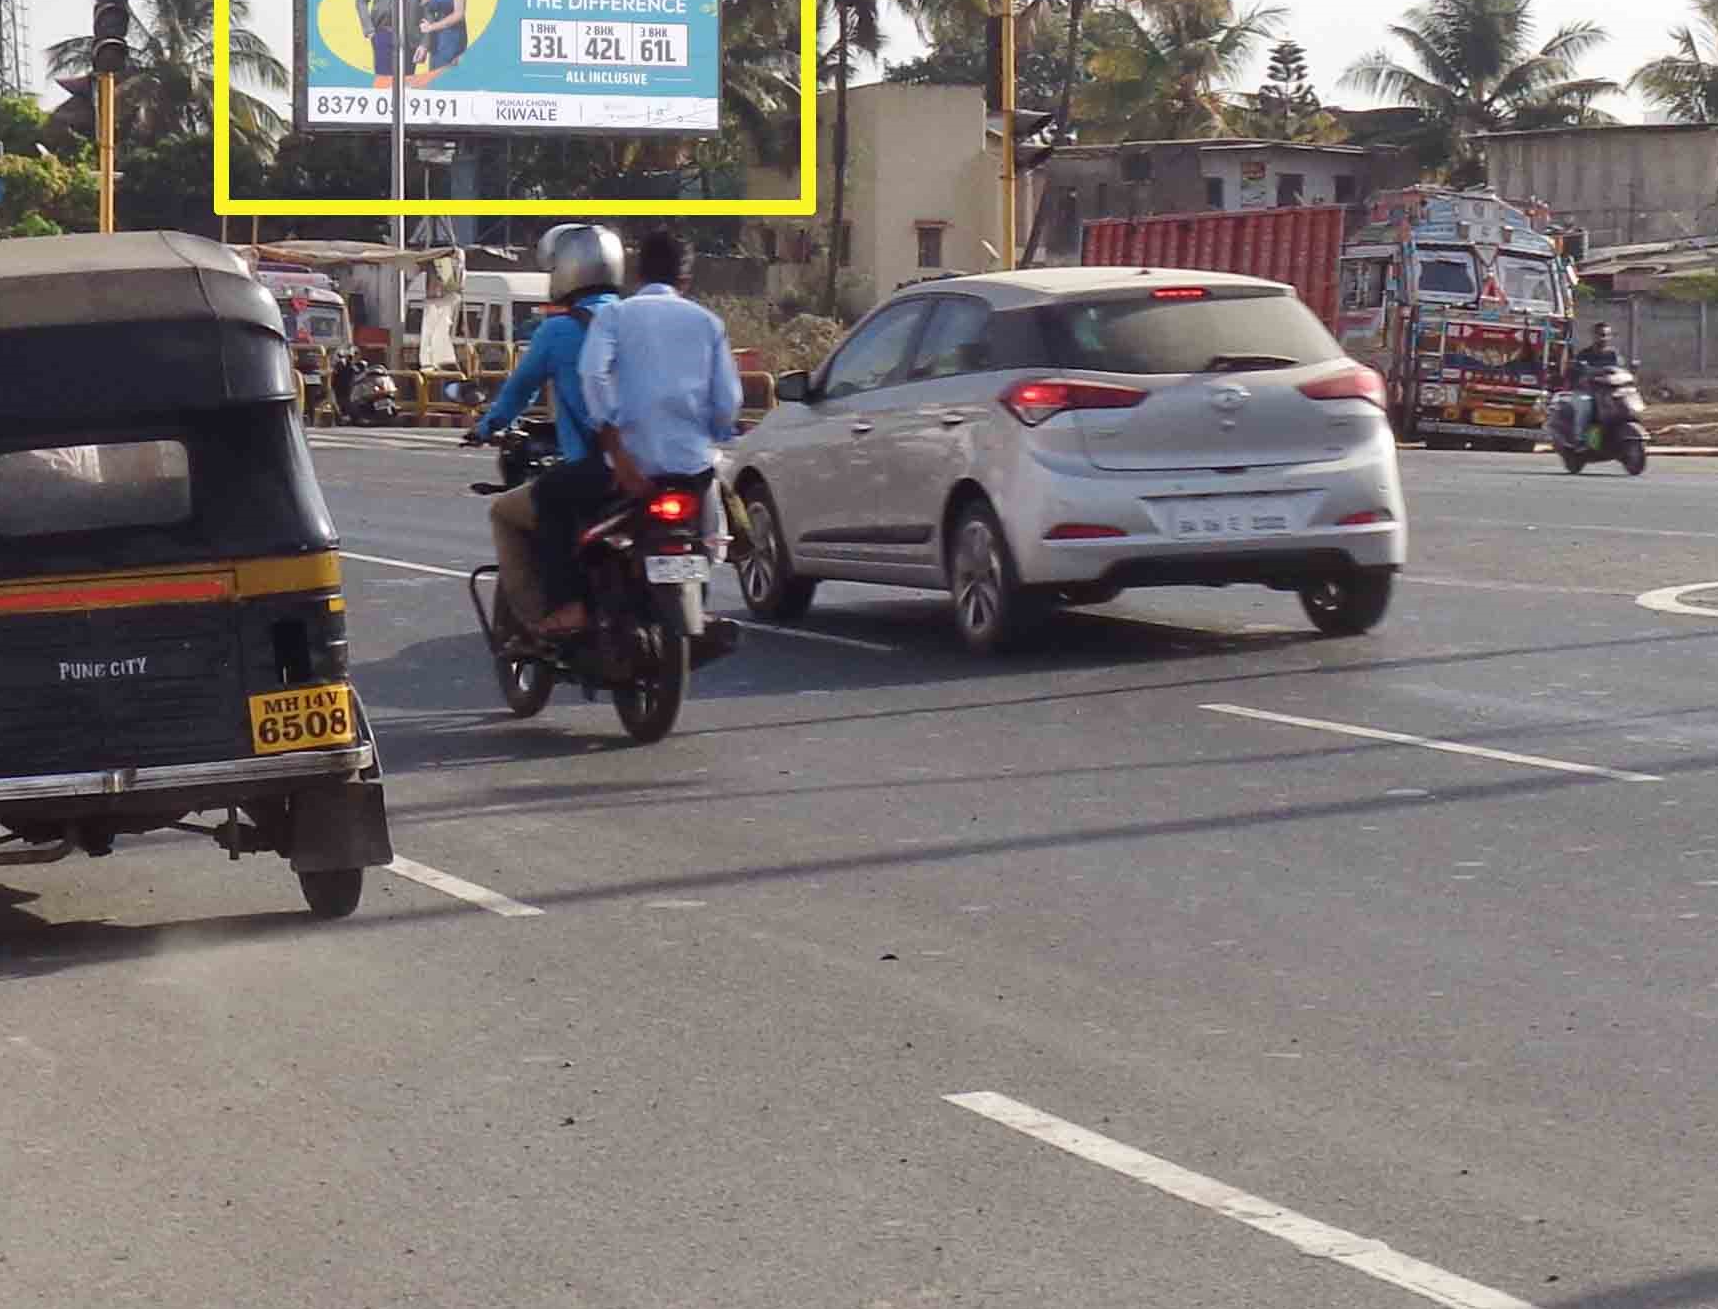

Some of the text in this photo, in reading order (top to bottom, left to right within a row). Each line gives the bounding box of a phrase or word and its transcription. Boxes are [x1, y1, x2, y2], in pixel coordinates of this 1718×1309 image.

[537, 24, 557, 35] BHK
[594, 26, 614, 36] BHK
[649, 28, 668, 38] BHK
[529, 36, 568, 59] 33L
[585, 38, 625, 61] 42L
[640, 40, 676, 63] 61L
[566, 70, 648, 86] ALL INCLUSIVE
[317, 95, 368, 115] 8379
[410, 99, 458, 118] 9191
[496, 108, 557, 122] KIWALE
[59, 657, 147, 680] PUNE CITY
[264, 697, 299, 714] MH
[259, 708, 347, 744] 6508
